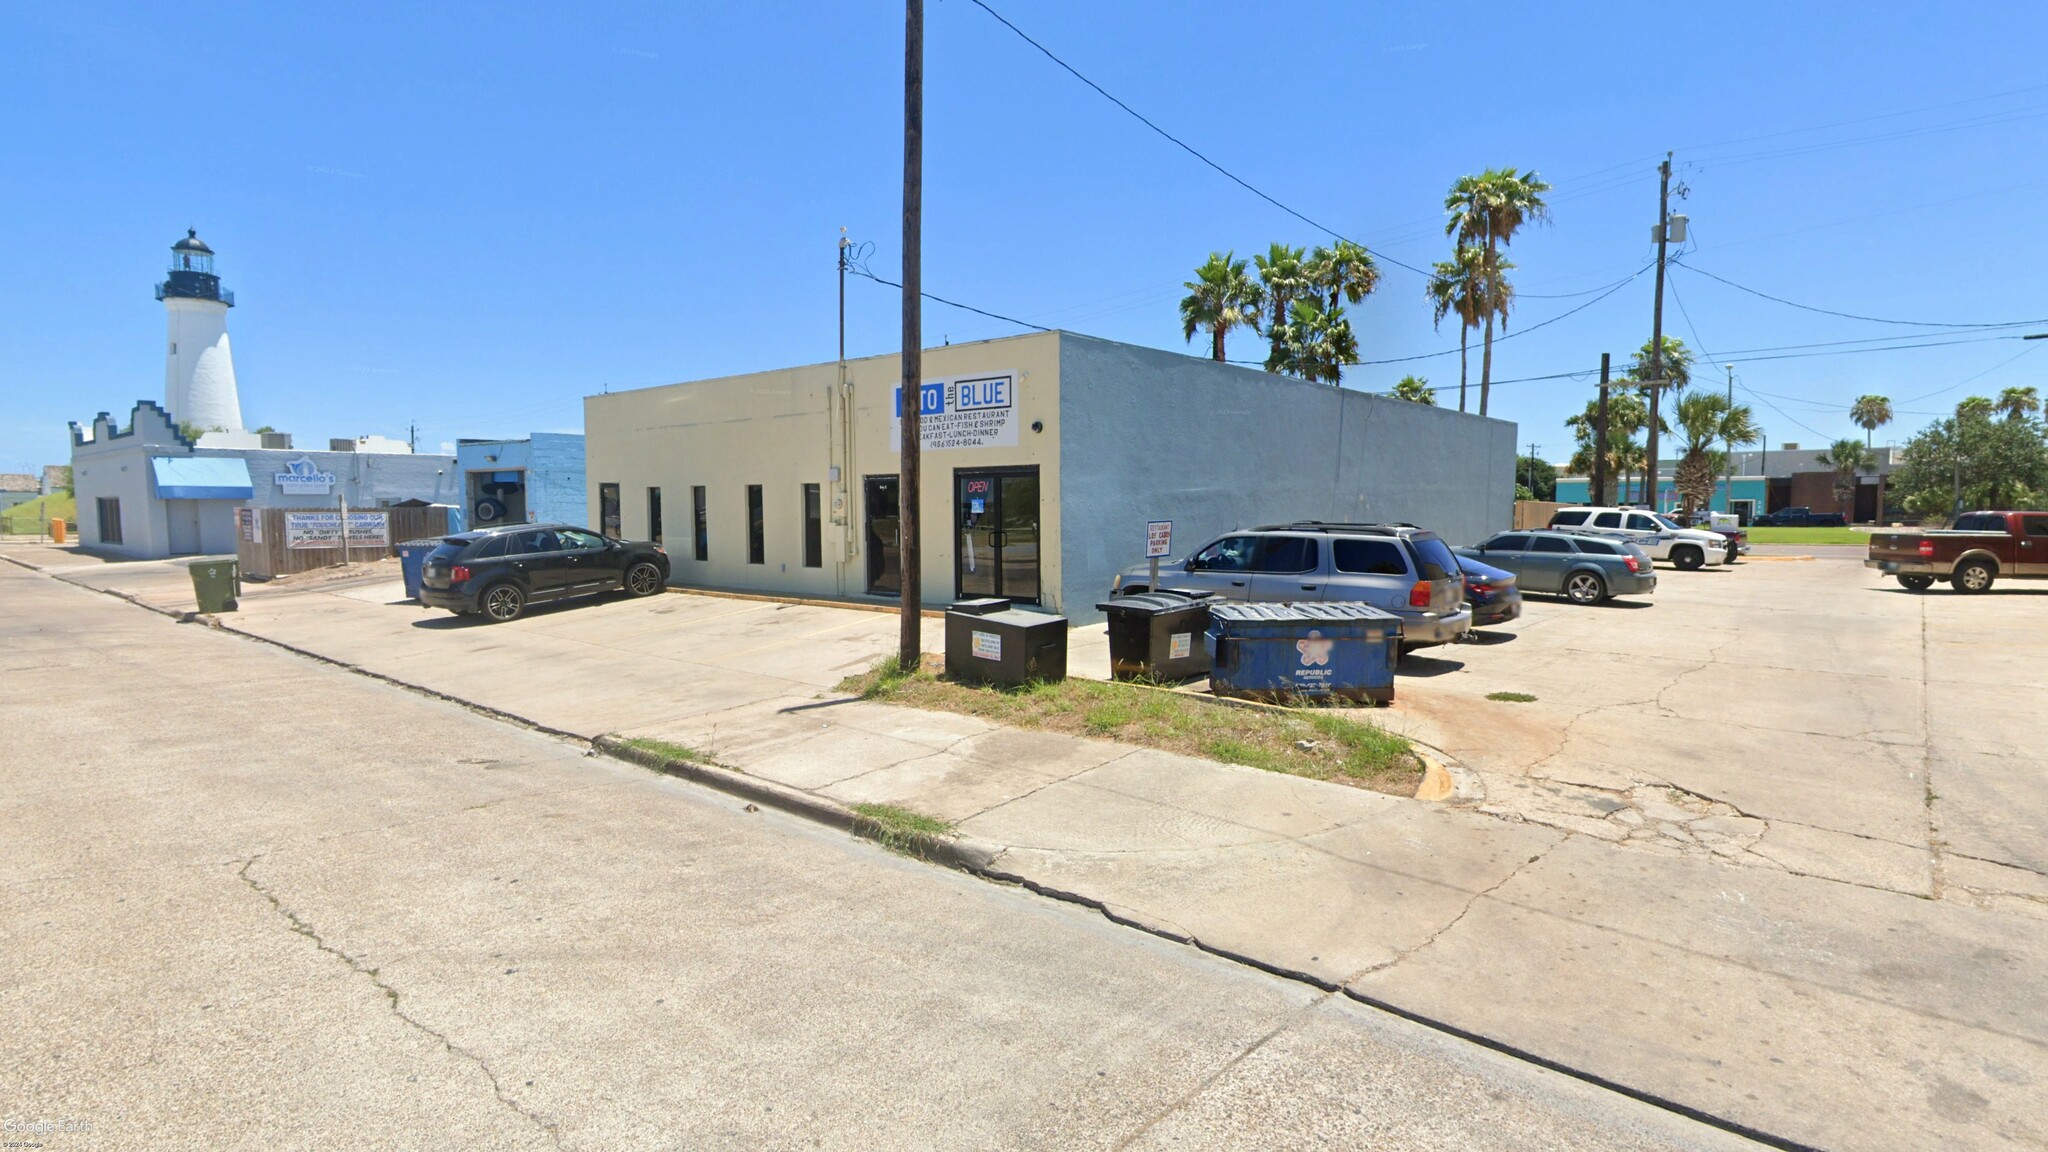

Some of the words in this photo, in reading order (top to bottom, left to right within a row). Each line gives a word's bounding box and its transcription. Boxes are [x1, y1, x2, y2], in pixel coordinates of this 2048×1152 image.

[920, 389, 937, 412] TO
[945, 386, 954, 407] the
[961, 382, 1004, 407] BLUE
[934, 414, 962, 423] MEXICAN
[963, 410, 1010, 421] RESTAURANT
[979, 419, 1006, 428] SHRIMP
[920, 428, 999, 440] EAKFAST-LUNCH-DINNER
[278, 473, 335, 483] marcello's
[967, 481, 989, 493] OPEN
